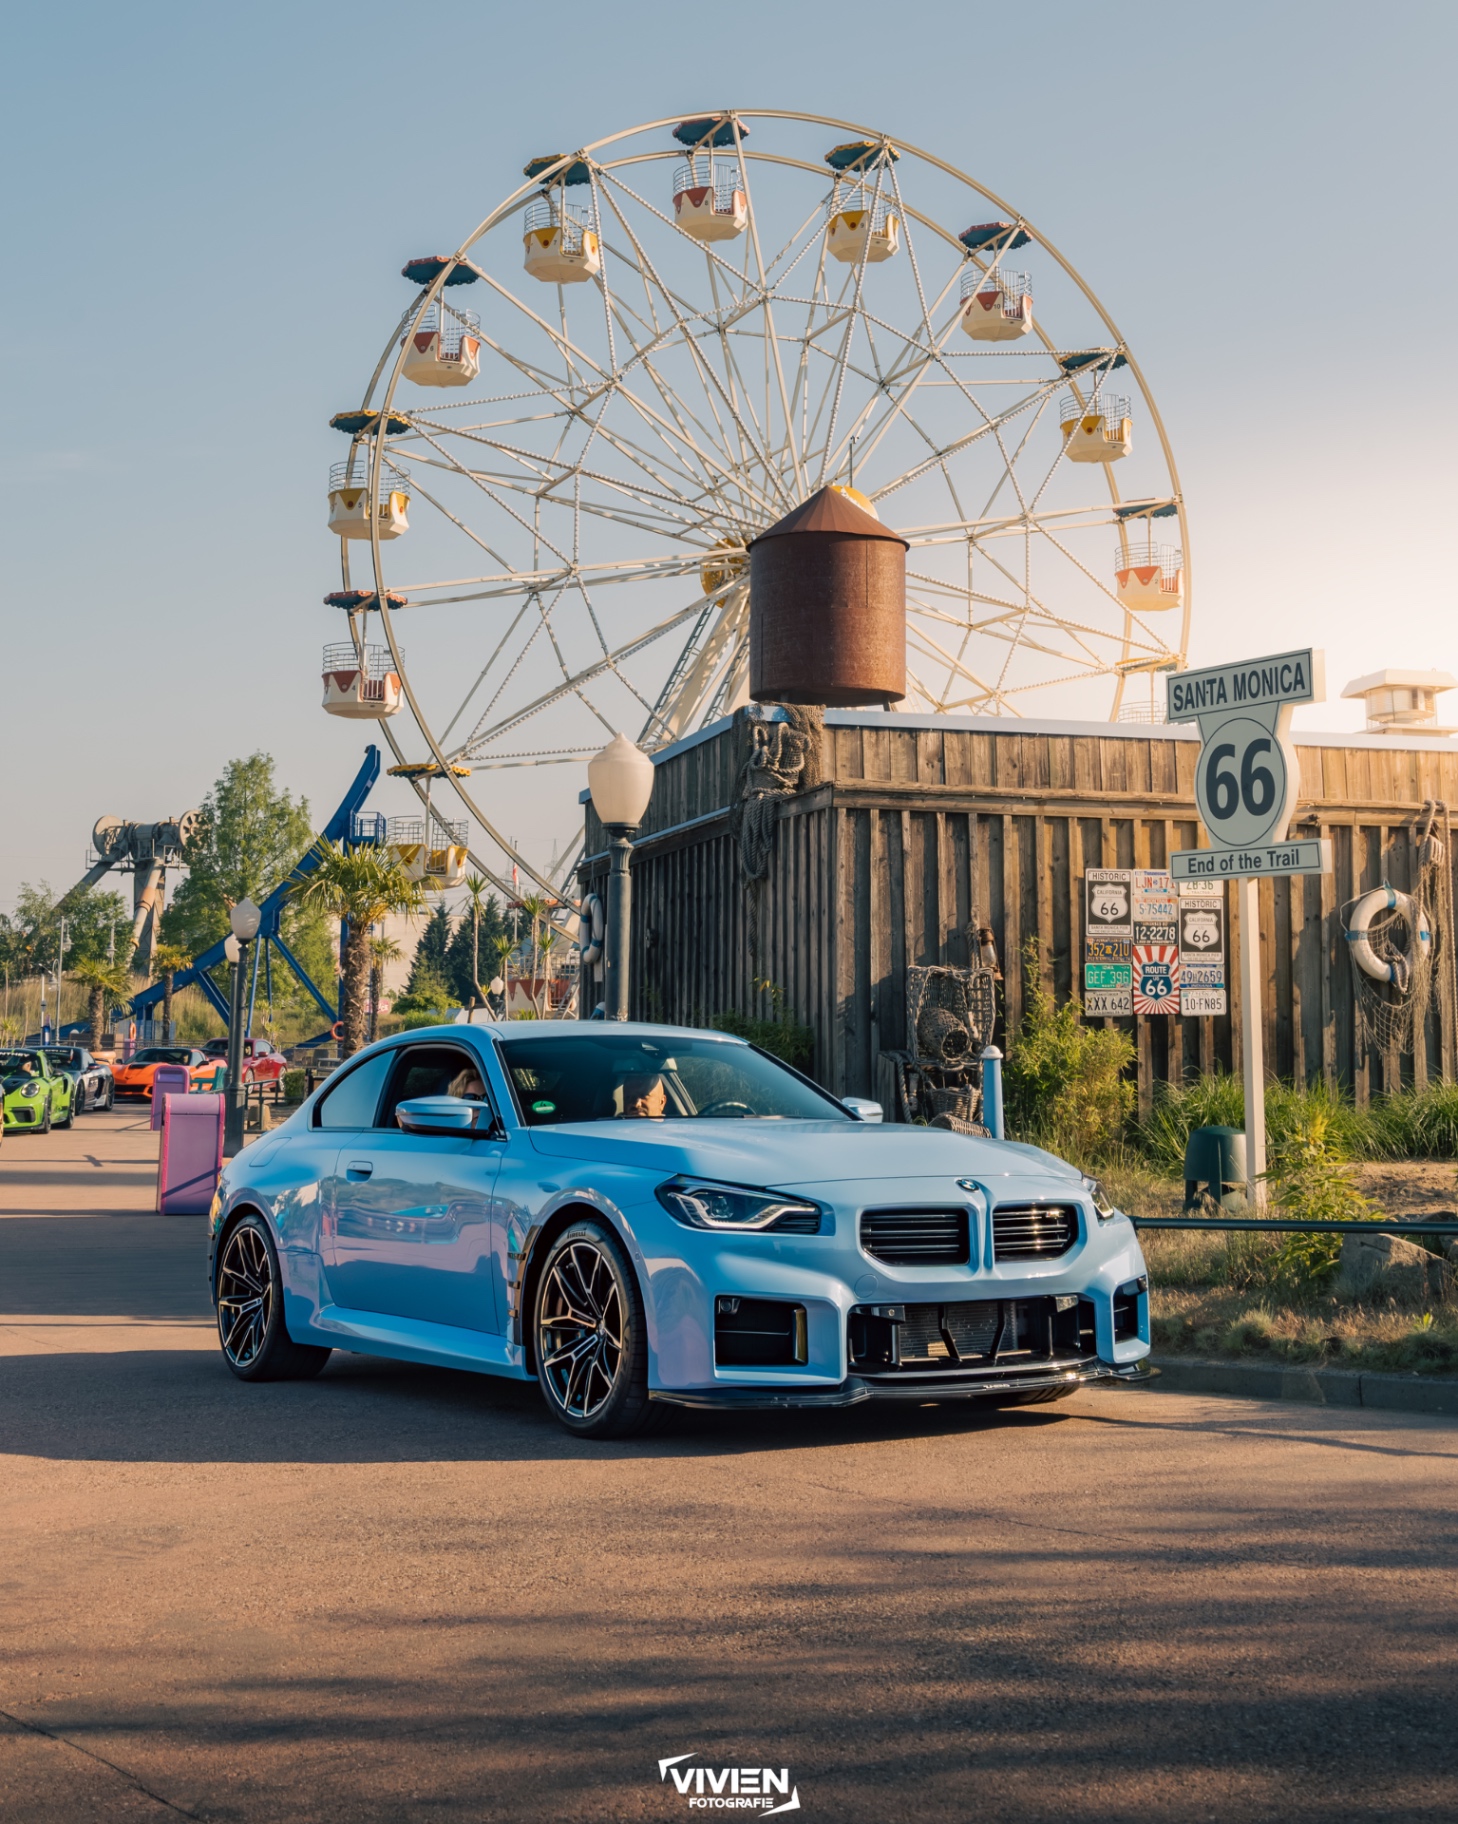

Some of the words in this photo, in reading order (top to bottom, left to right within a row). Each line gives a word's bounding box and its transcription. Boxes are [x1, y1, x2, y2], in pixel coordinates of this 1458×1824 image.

[1173, 676, 1228, 712] SANTA
[1233, 662, 1306, 702] MONICA
[1206, 738, 1276, 820] 66
[1188, 855, 1215, 874] End
[1219, 853, 1234, 871] of
[1238, 852, 1262, 870] the
[1267, 849, 1299, 867] Trail
[1092, 873, 1127, 881] HISTORIC
[1100, 902, 1119, 916] 66
[1184, 900, 1217, 908] HISTORIC
[1192, 930, 1211, 943] 66
[1088, 942, 1105, 957] 352
[1144, 965, 1167, 974] ROUTE
[1088, 971, 1107, 984] GEF
[1110, 971, 1129, 984] 396
[1145, 979, 1168, 996] 66
[1111, 997, 1130, 1010] 642
